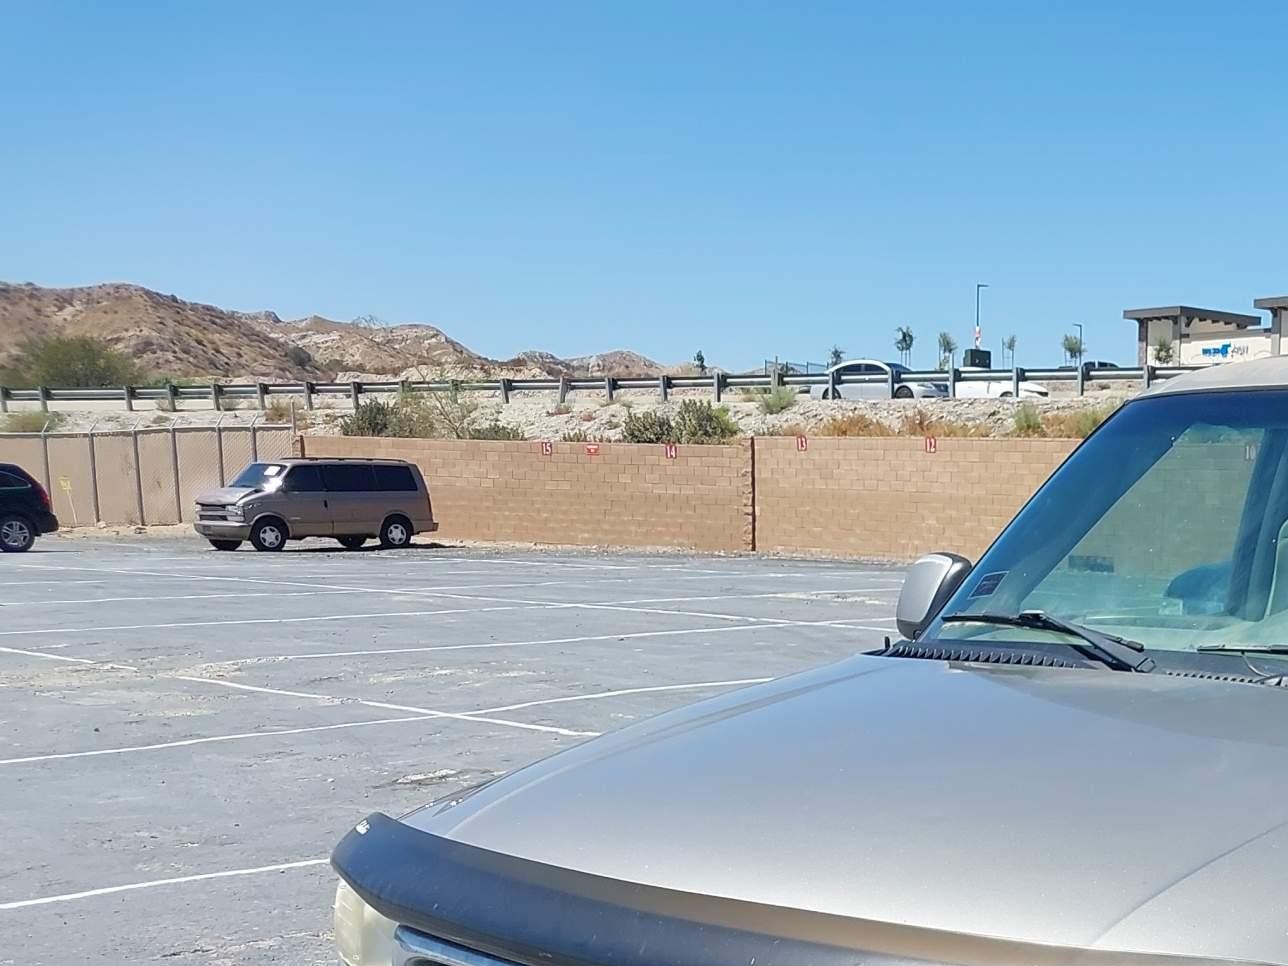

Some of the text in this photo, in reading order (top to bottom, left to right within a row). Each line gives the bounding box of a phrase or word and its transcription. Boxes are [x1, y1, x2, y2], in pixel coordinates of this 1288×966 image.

[542, 441, 552, 454] 15
[797, 436, 807, 450] 13
[926, 437, 936, 452] 12
[666, 444, 677, 457] 14
